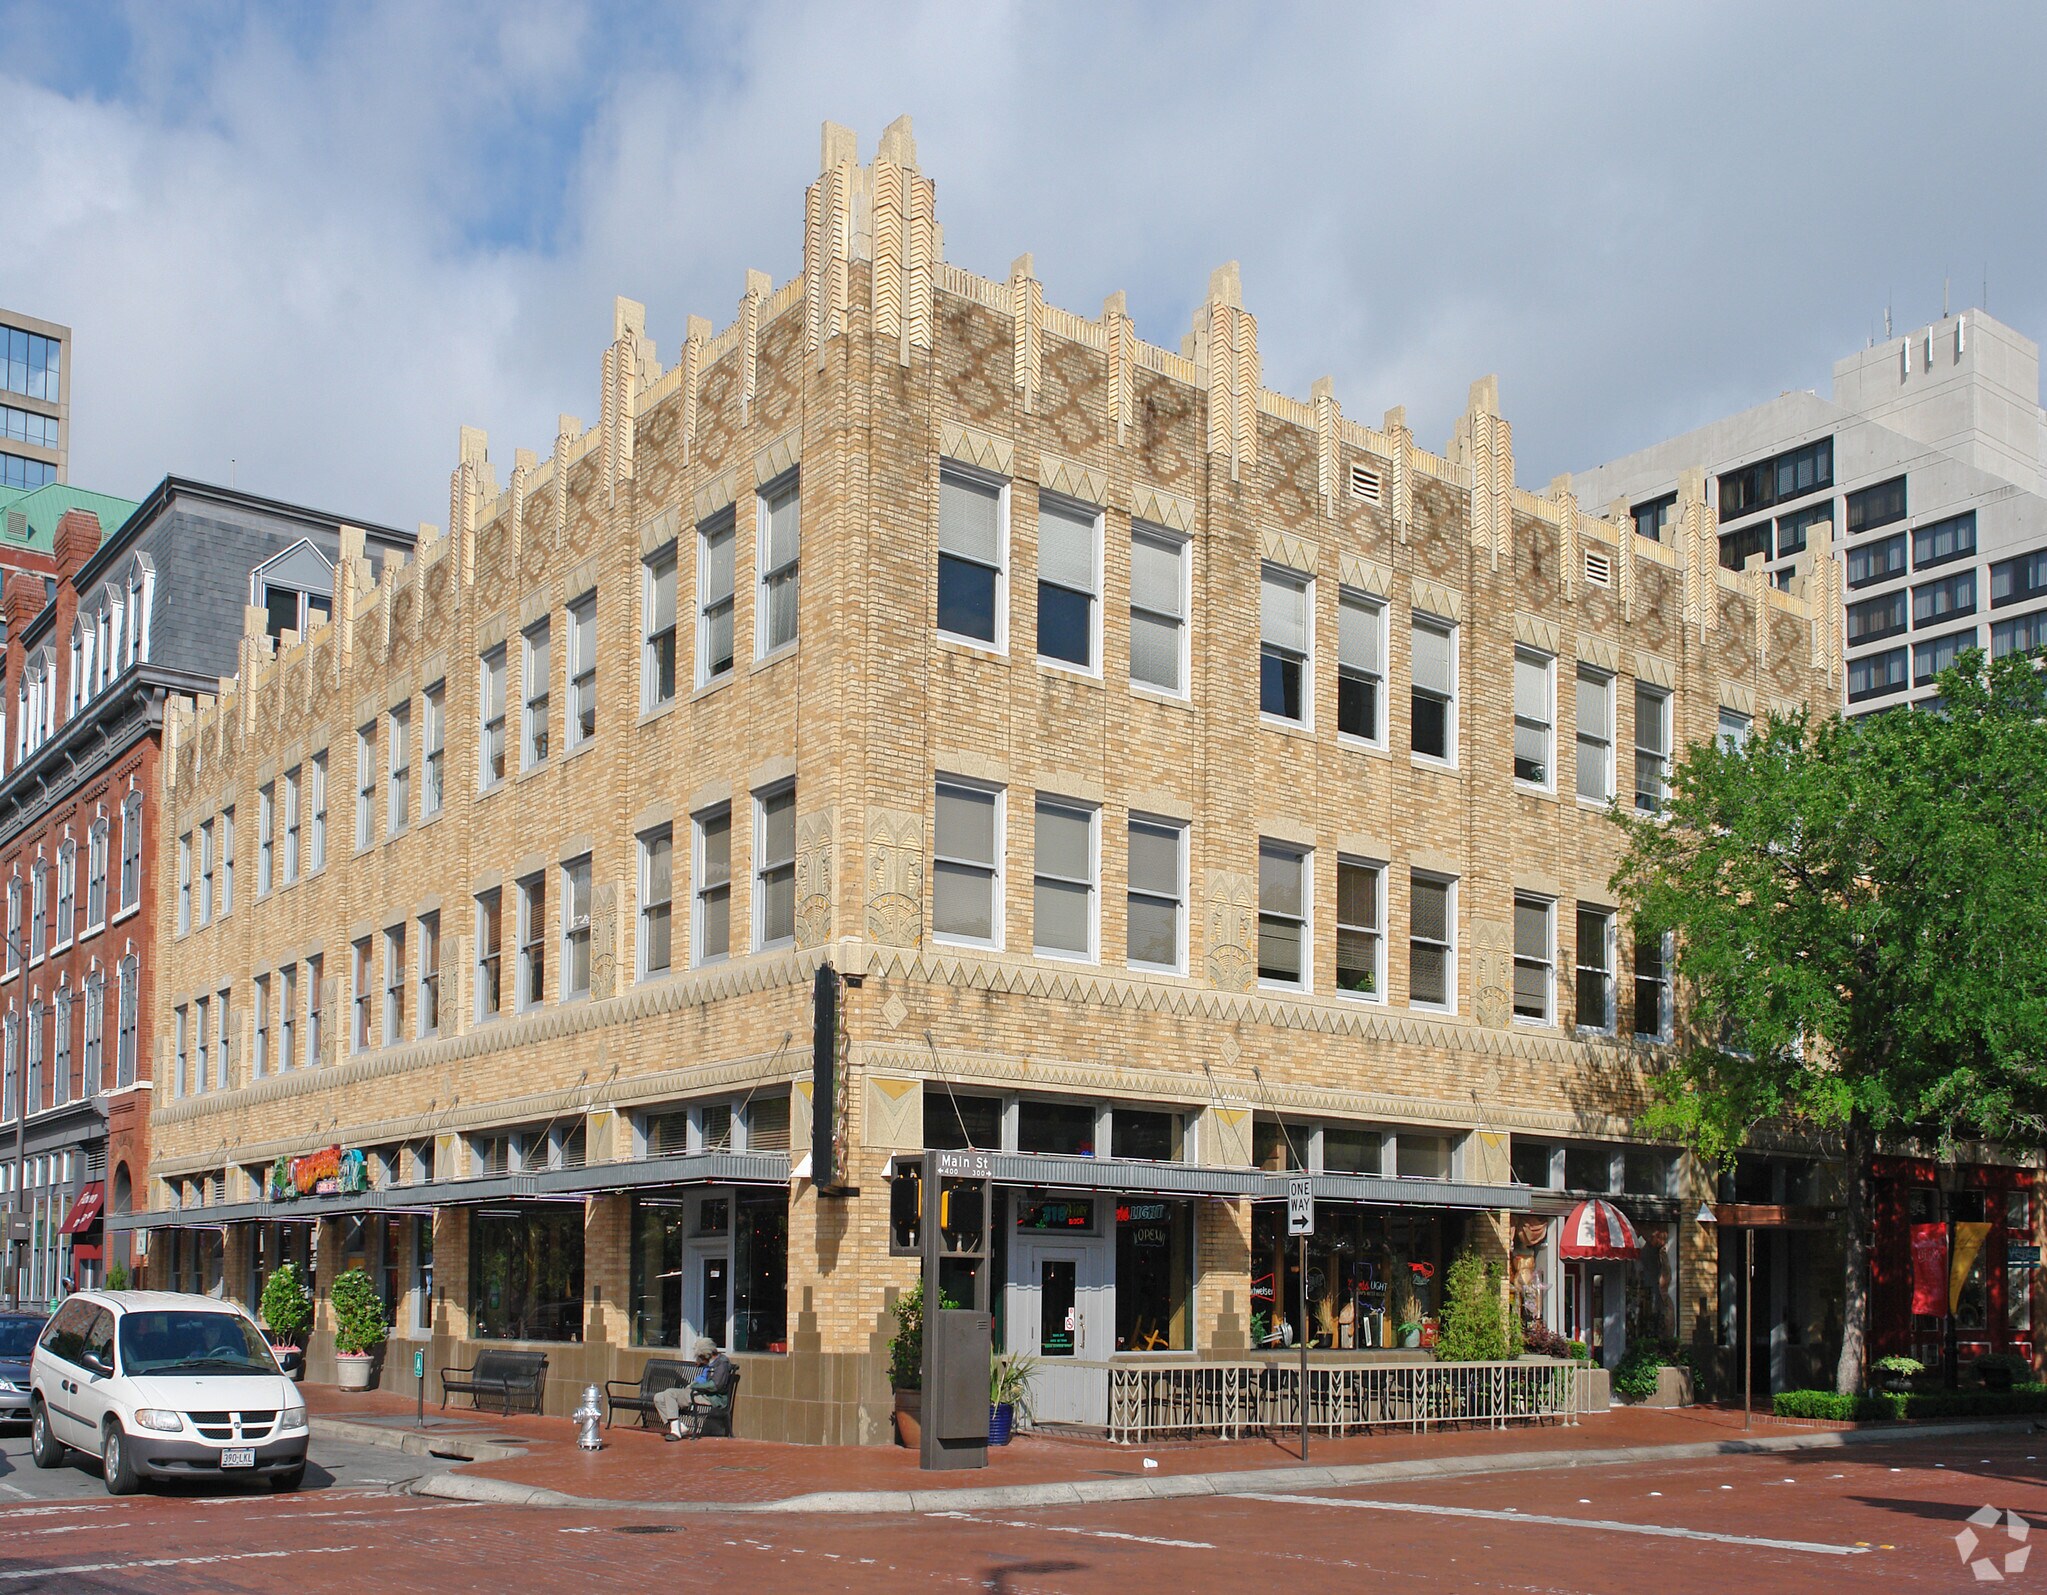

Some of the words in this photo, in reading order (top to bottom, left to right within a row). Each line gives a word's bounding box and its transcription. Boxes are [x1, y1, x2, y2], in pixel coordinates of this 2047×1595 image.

[941, 1154, 970, 1168] Main
[975, 1156, 989, 1169] St
[972, 1169, 986, 1177] 300
[1291, 1182, 1310, 1196] ONE
[1130, 1204, 1164, 1220] LIGHT
[1291, 1198, 1310, 1212] WAY
[1138, 1228, 1163, 1243] OPEN
[1370, 1280, 1388, 1292] LIGHT
